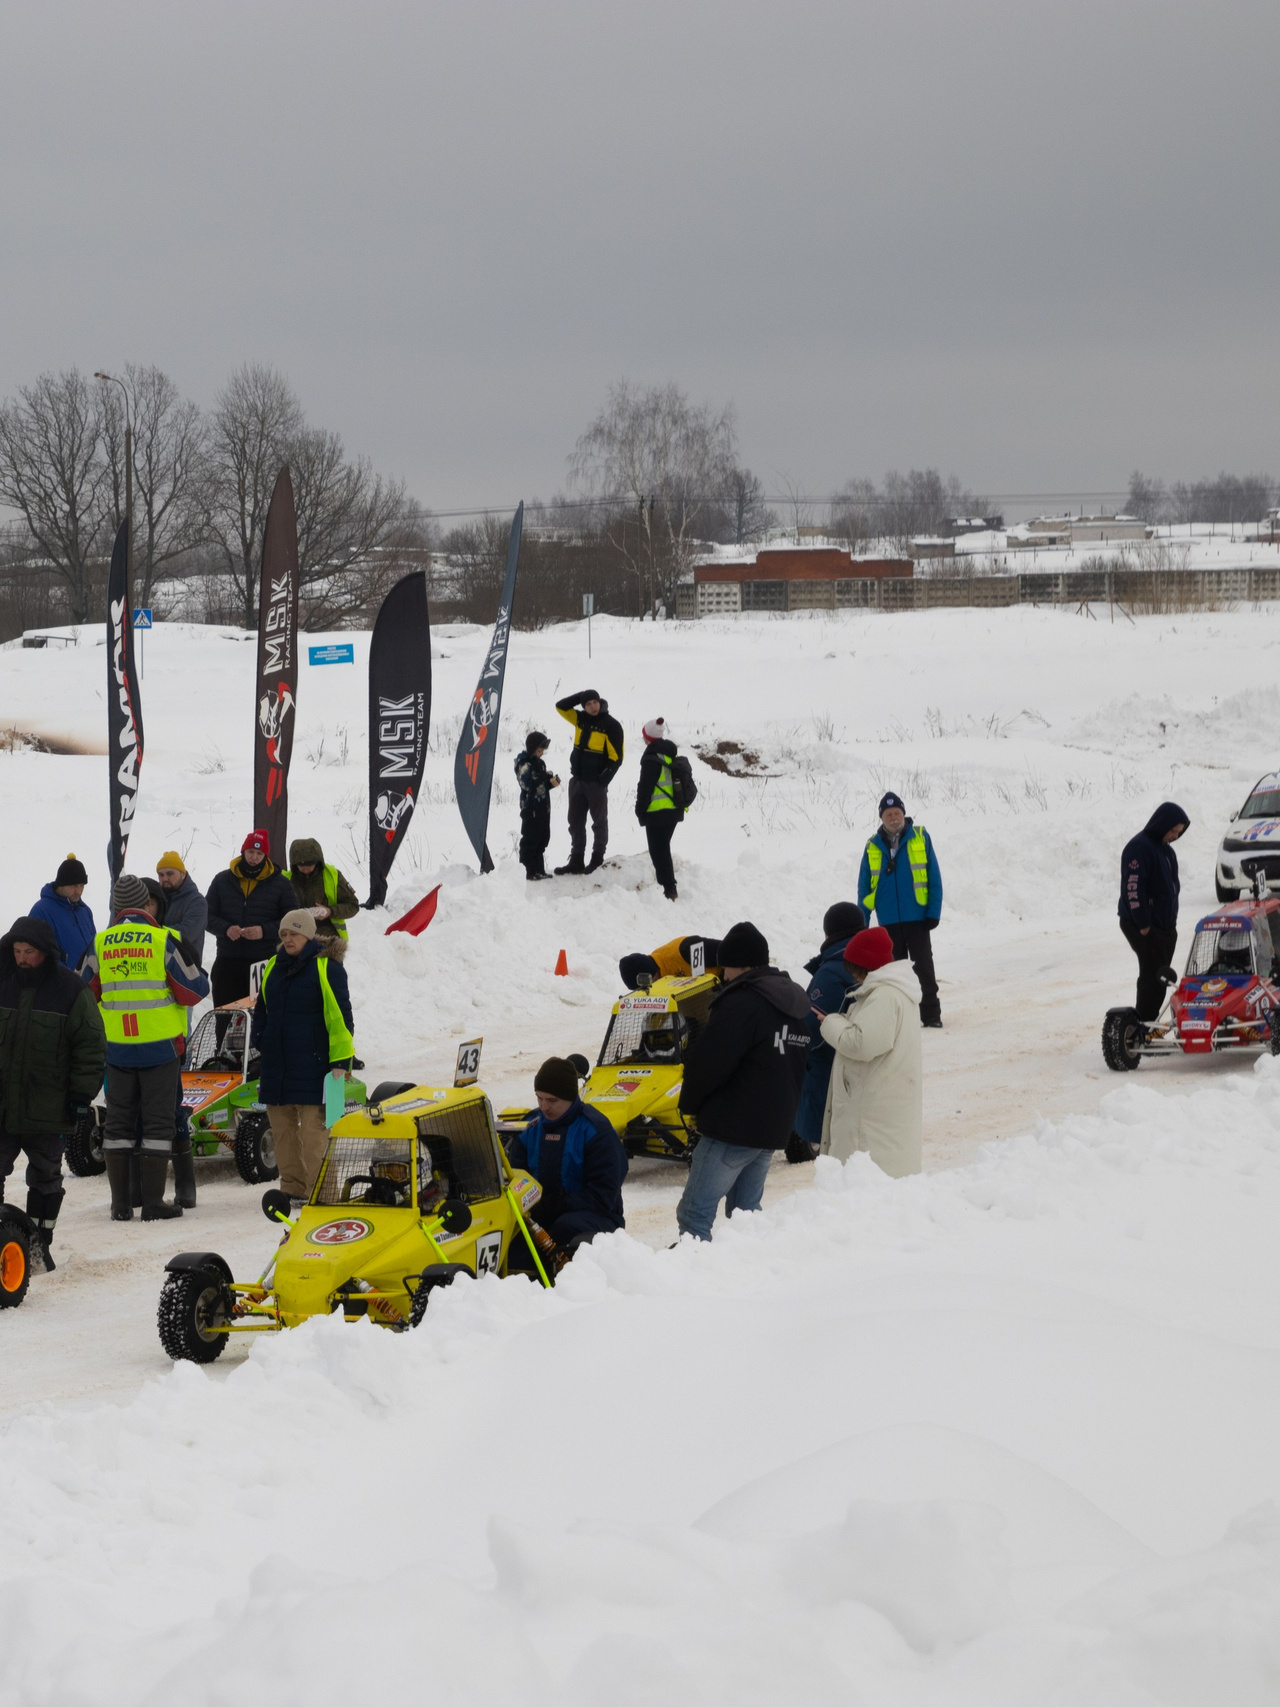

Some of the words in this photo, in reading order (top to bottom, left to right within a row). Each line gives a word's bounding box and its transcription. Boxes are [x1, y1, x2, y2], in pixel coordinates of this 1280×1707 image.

[263, 572, 288, 675] MSK
[284, 613, 292, 668] RACING
[379, 693, 414, 777] MSK
[413, 729, 423, 775] RACING
[104, 931, 152, 946] RUSTA
[103, 948, 153, 961] МАРШАЛ
[130, 961, 148, 972] MSK
[693, 946, 703, 969] 81
[458, 1048, 479, 1074] 43
[478, 1244, 499, 1274] 43
